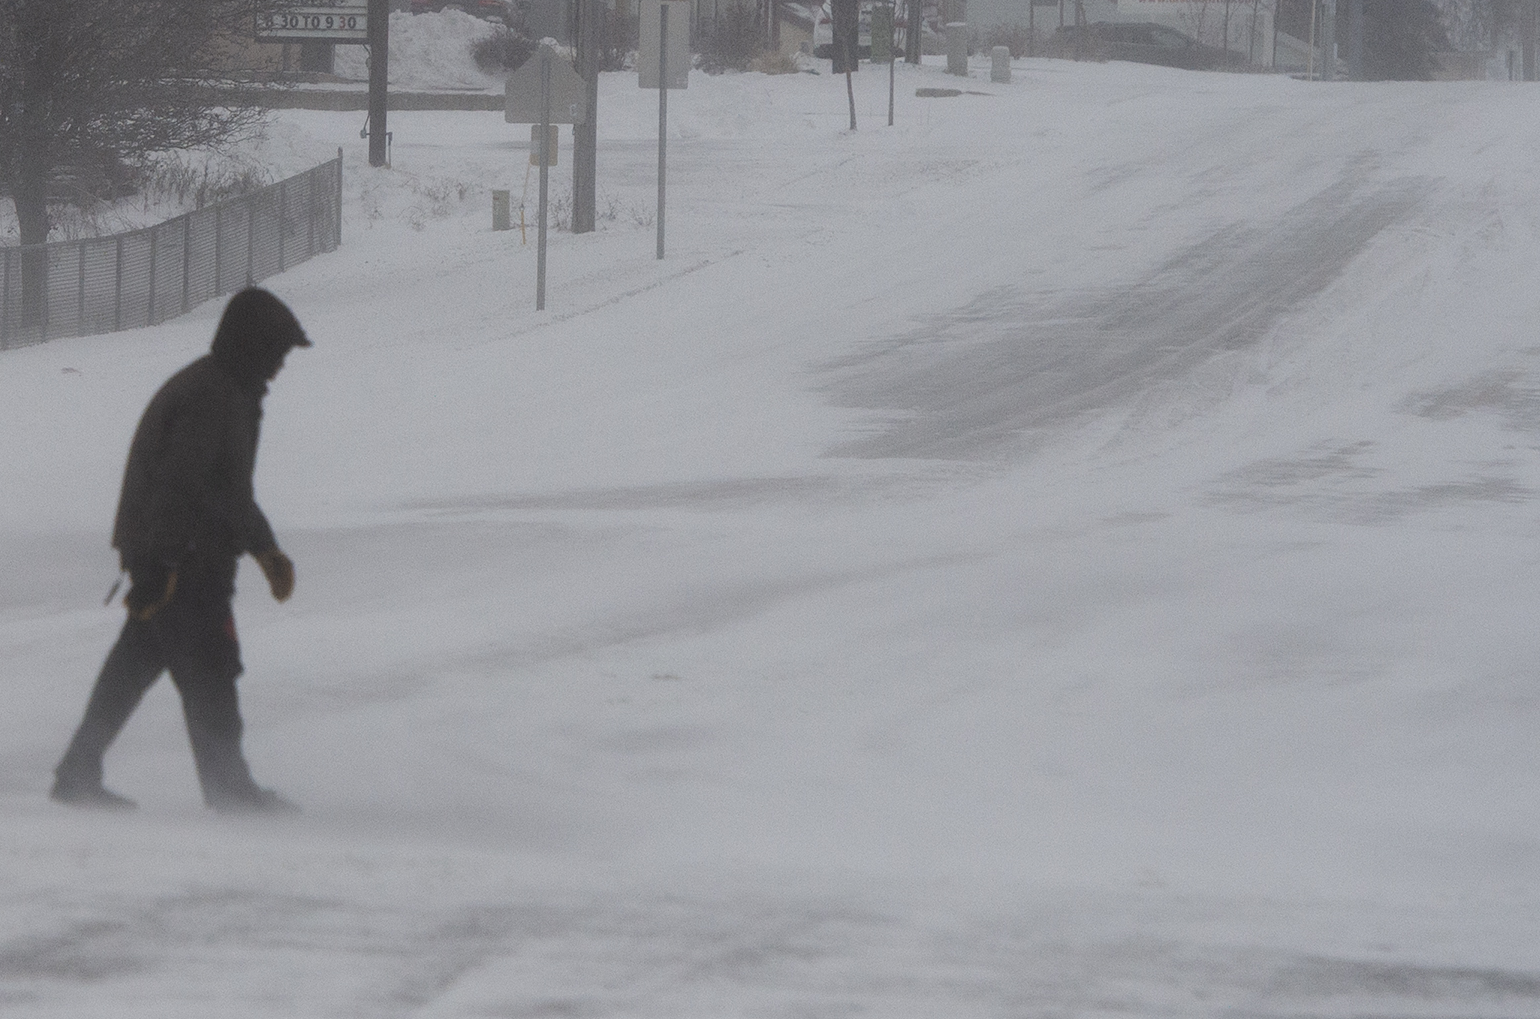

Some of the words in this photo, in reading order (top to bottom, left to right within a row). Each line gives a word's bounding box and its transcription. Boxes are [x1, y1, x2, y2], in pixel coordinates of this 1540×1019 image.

[282, 15, 299, 28] 30
[325, 16, 334, 28] 9
[339, 16, 356, 28] 30
